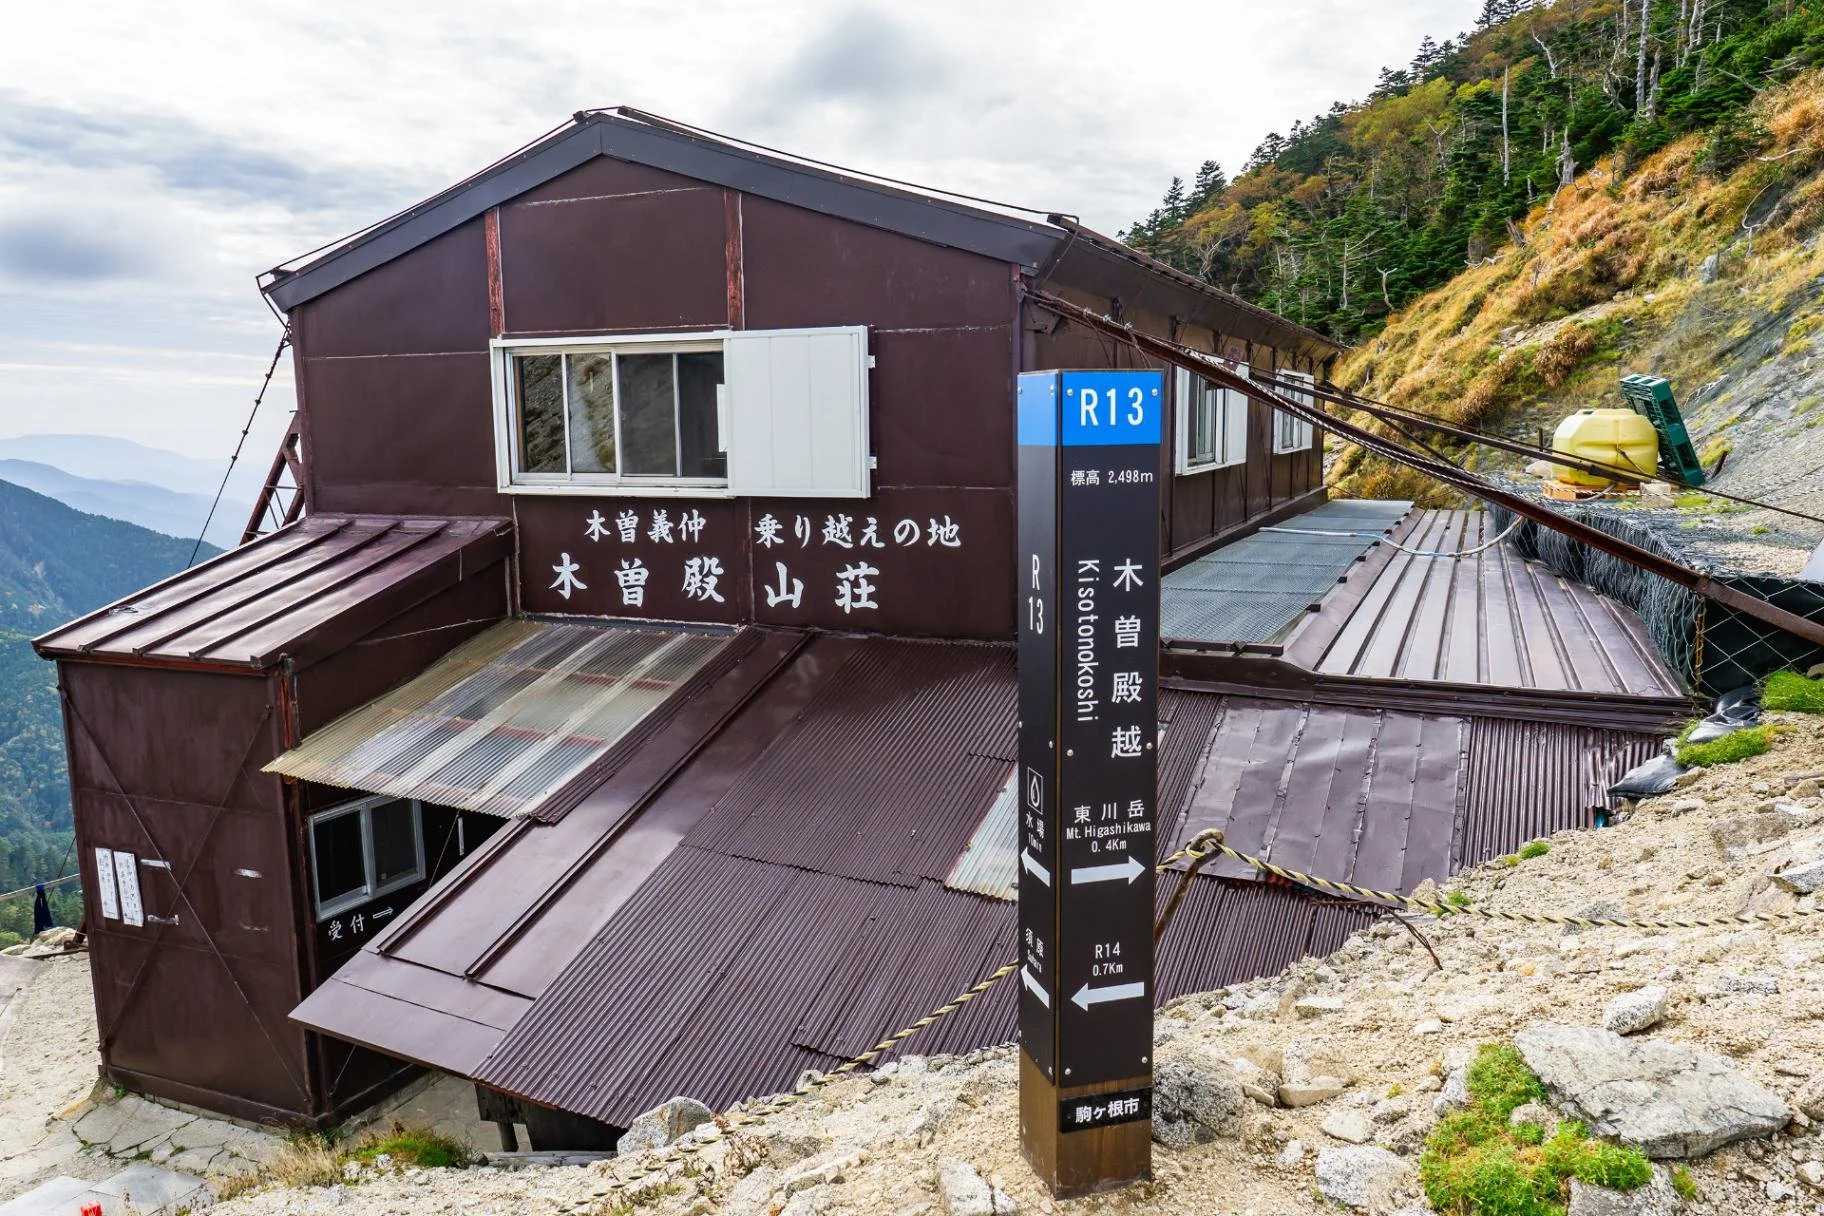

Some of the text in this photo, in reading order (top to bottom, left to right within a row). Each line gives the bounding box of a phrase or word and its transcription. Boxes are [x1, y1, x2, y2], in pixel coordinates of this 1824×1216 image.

[1080, 387, 1144, 427] R13
[1071, 469, 1153, 486] 標高 2,498m
[584, 508, 962, 549] 木曽義仲 乗り越えの地
[1077, 559, 1100, 722] Kisotonokoshi
[1111, 557, 1144, 759] 木曽殿越
[1074, 799, 1145, 824] 東川岳
[1066, 821, 1152, 840] Mt. Higashikawa
[328, 913, 365, 941] 受付
[1095, 942, 1121, 959] R14
[1092, 962, 1124, 977] 0.7Km
